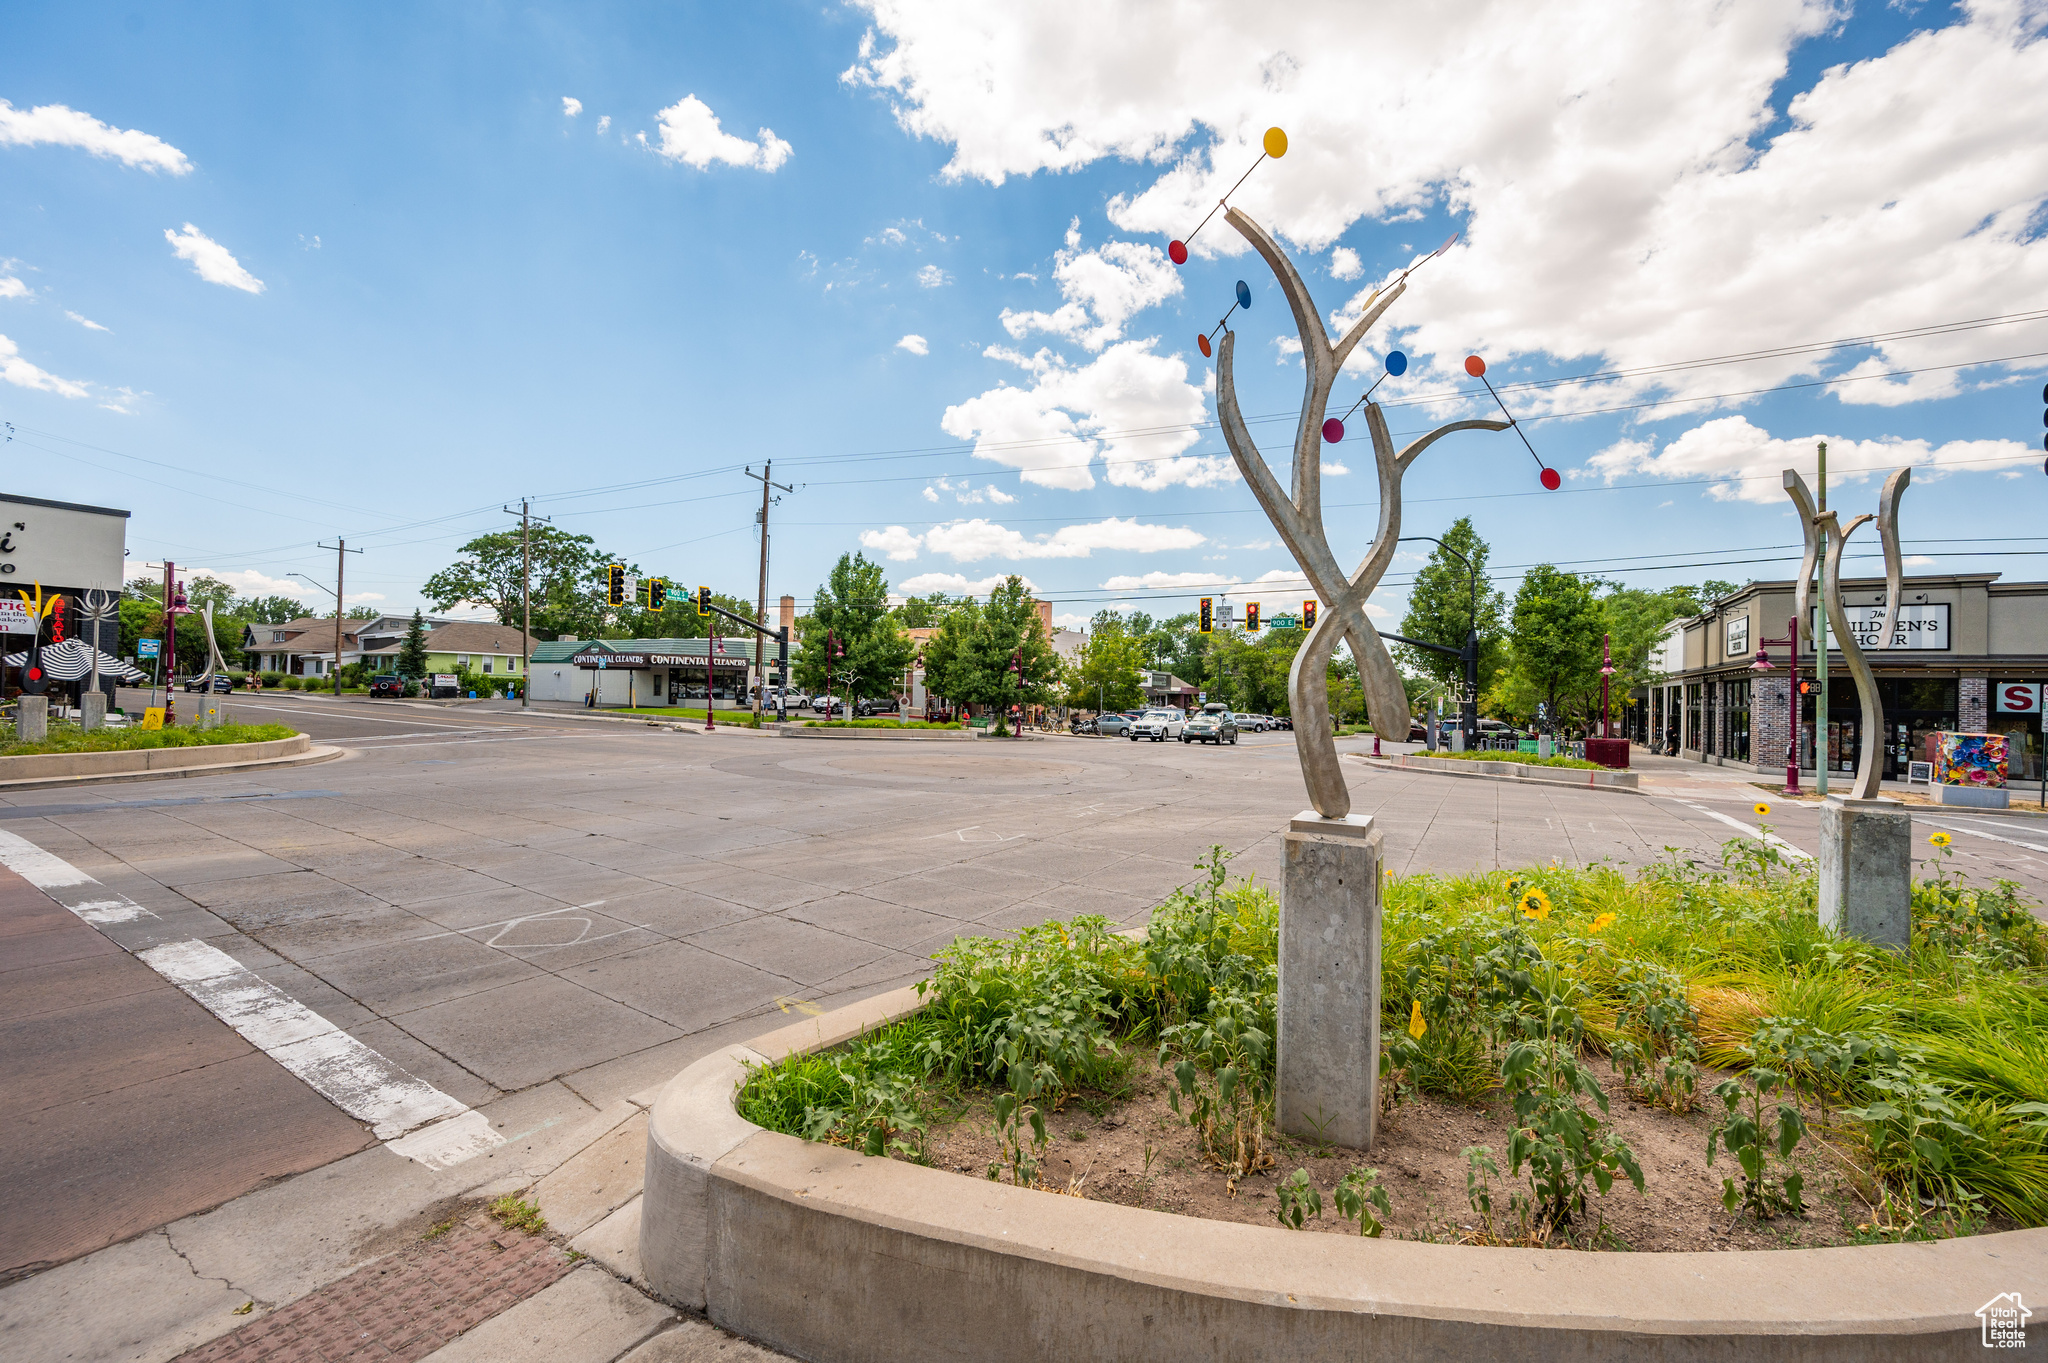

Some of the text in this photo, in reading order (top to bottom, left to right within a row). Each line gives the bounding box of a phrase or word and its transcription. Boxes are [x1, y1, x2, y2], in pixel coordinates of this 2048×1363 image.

[52, 598, 65, 642] GELATO
[1826, 620, 1938, 632] ILDEN'S
[1856, 634, 1907, 645] HOR
[615, 655, 644, 664] CLEANERS
[650, 655, 747, 667] CONTINENTAL CLEANERS
[2003, 685, 2034, 711] S
